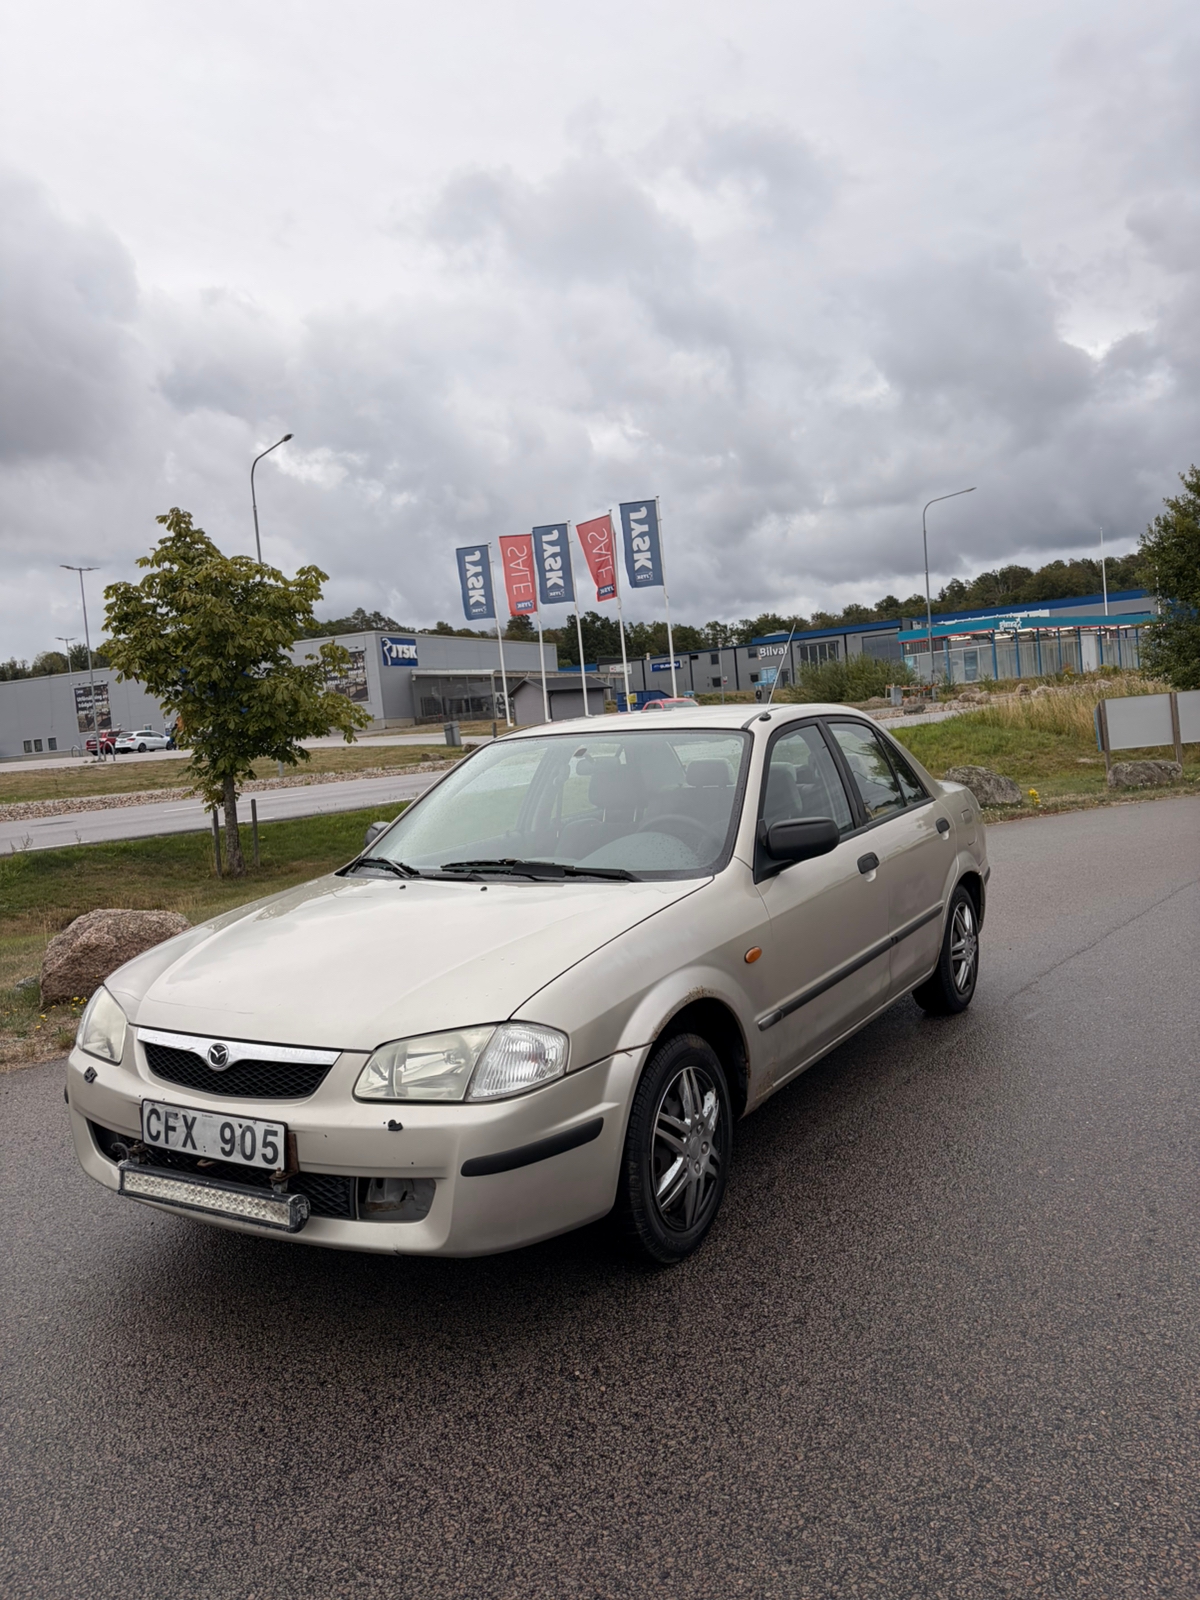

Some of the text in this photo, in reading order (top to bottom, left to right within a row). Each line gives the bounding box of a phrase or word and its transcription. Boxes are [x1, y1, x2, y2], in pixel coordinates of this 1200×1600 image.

[390, 644, 418, 659] JYSK
[146, 1107, 279, 1165] CFX 905
